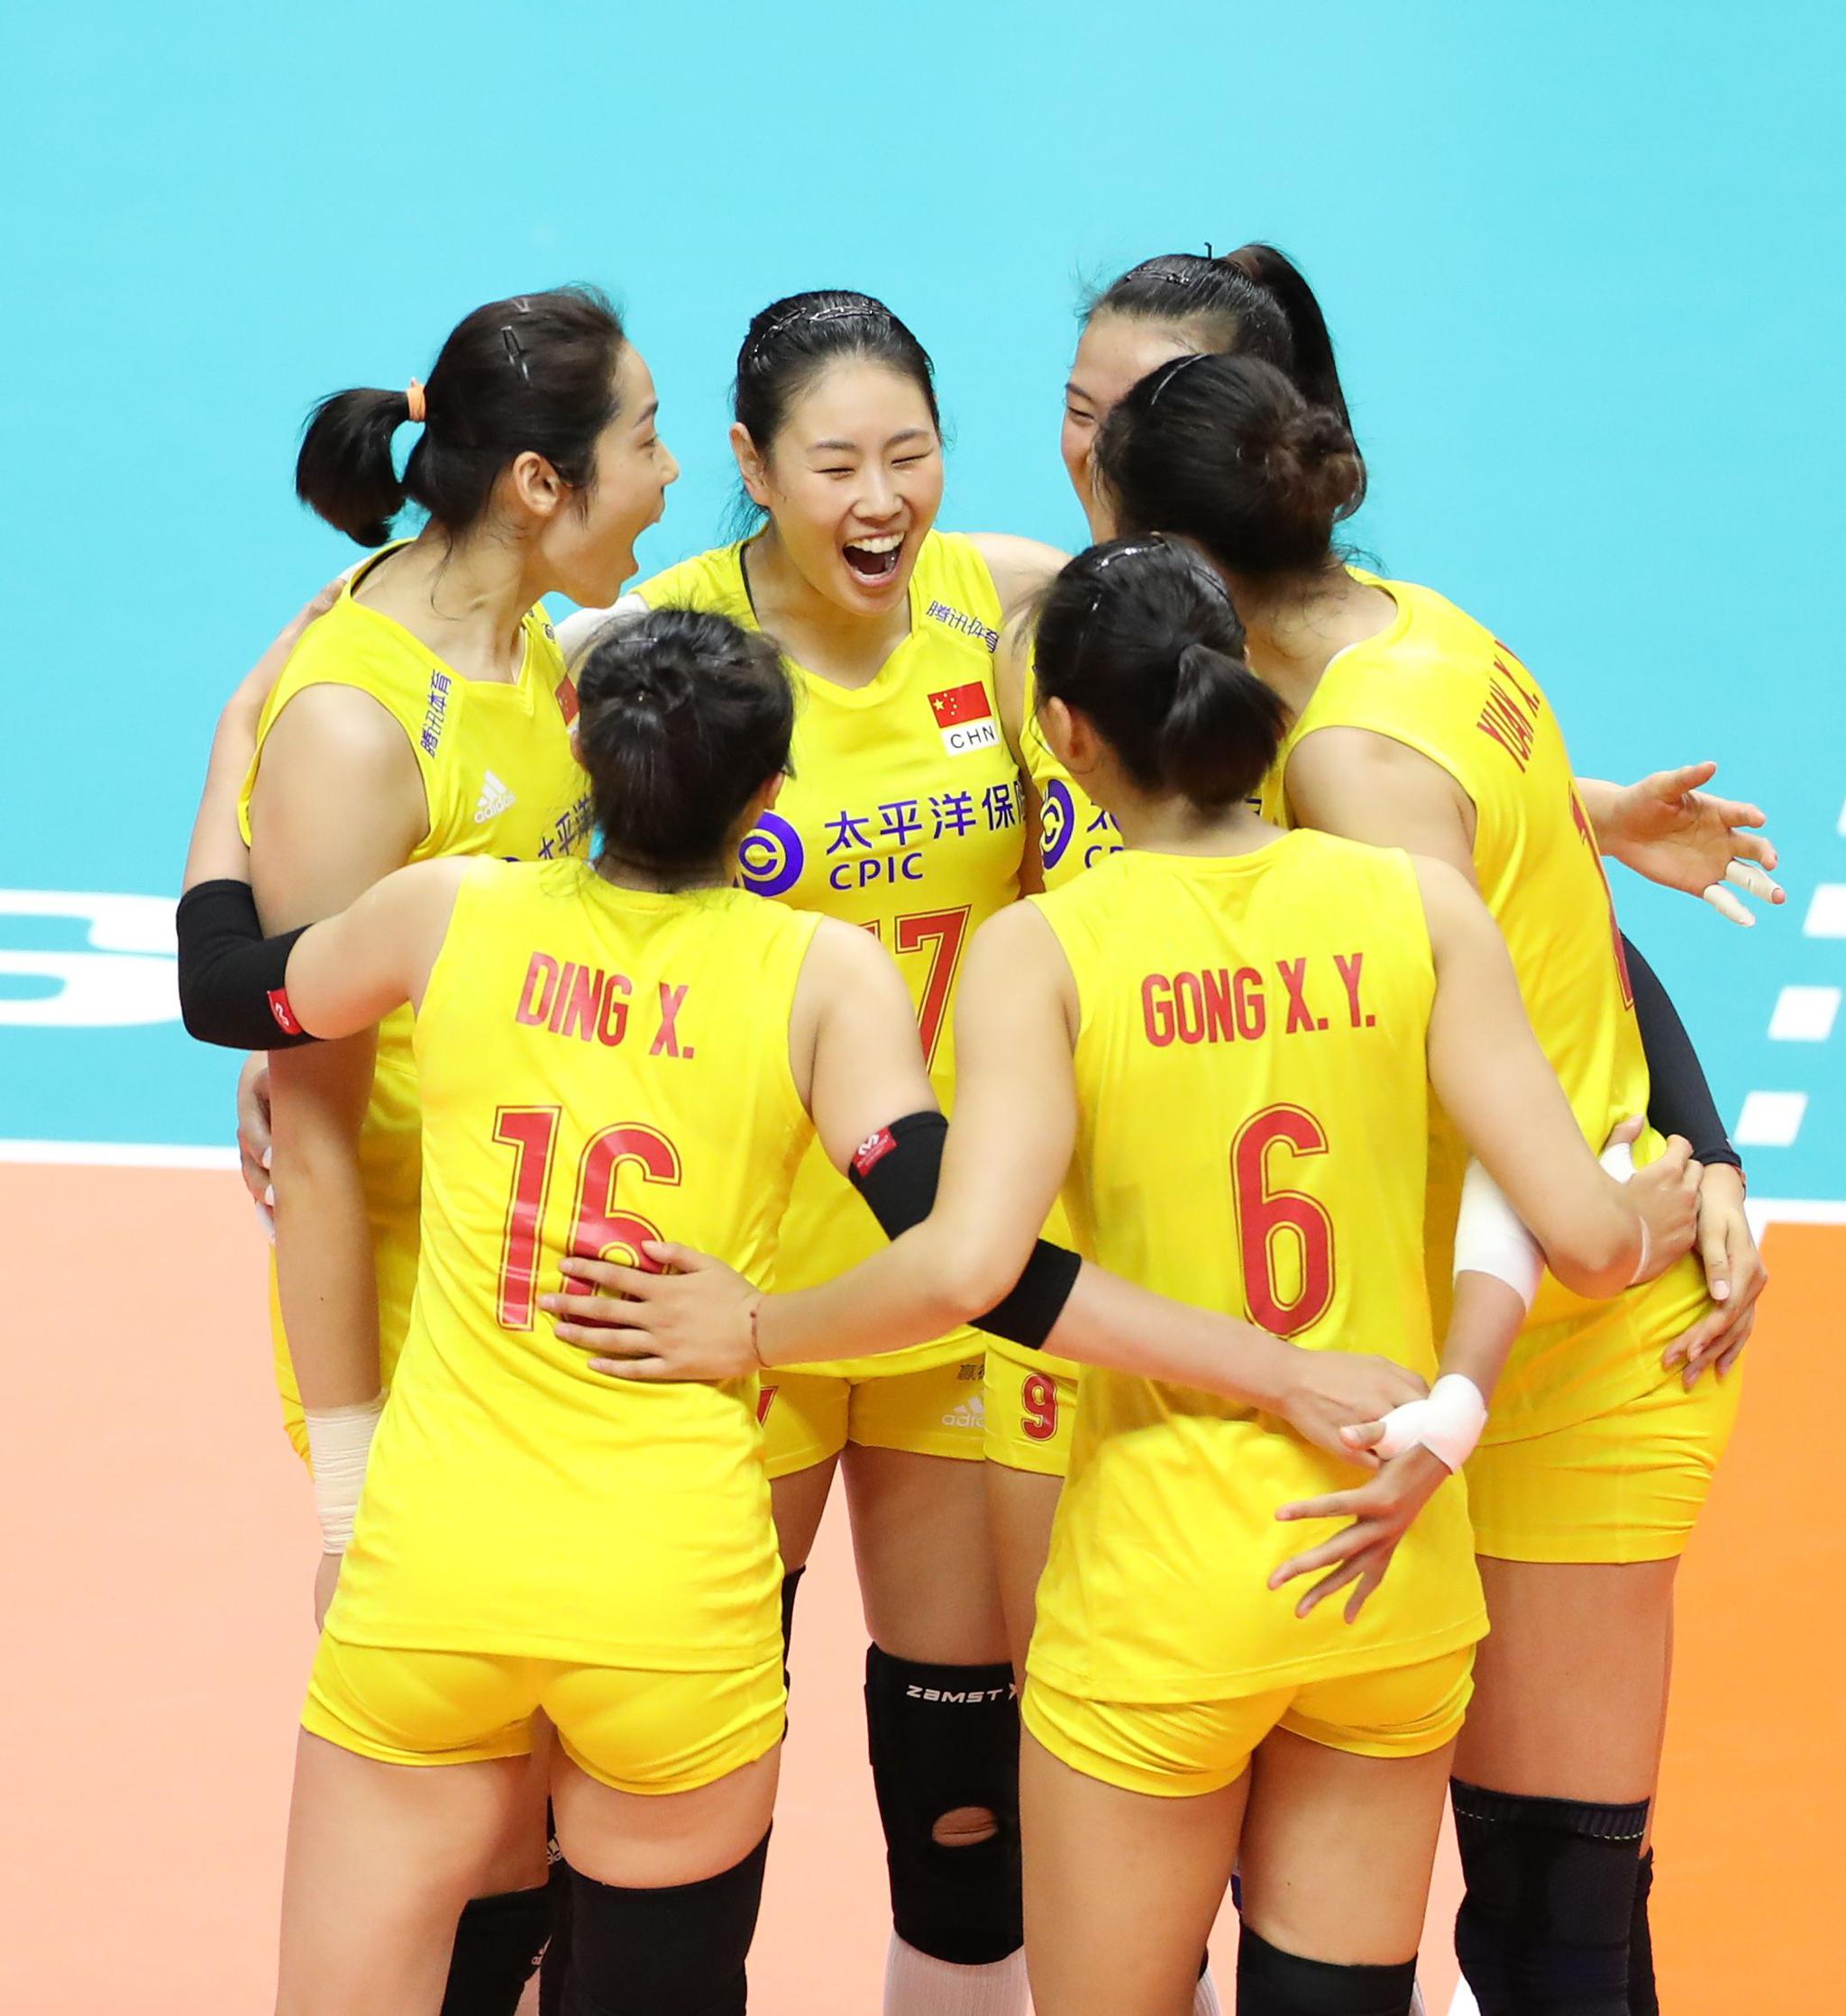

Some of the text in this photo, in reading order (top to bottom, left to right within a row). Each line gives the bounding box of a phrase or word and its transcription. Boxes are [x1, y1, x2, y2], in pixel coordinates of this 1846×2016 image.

[926, 600, 999, 653] 腾讯体育
[420, 669, 452, 759] 腾讯体育
[950, 725, 995, 749] CHN
[473, 791, 516, 824] adidas
[829, 853, 924, 890] CPIC
[515, 951, 695, 1060] DING X.
[1140, 952, 1376, 1048] GONG X. Y.
[491, 1105, 682, 1332] 16
[1229, 1101, 1337, 1341] 6
[1020, 1372, 1058, 1442] 9
